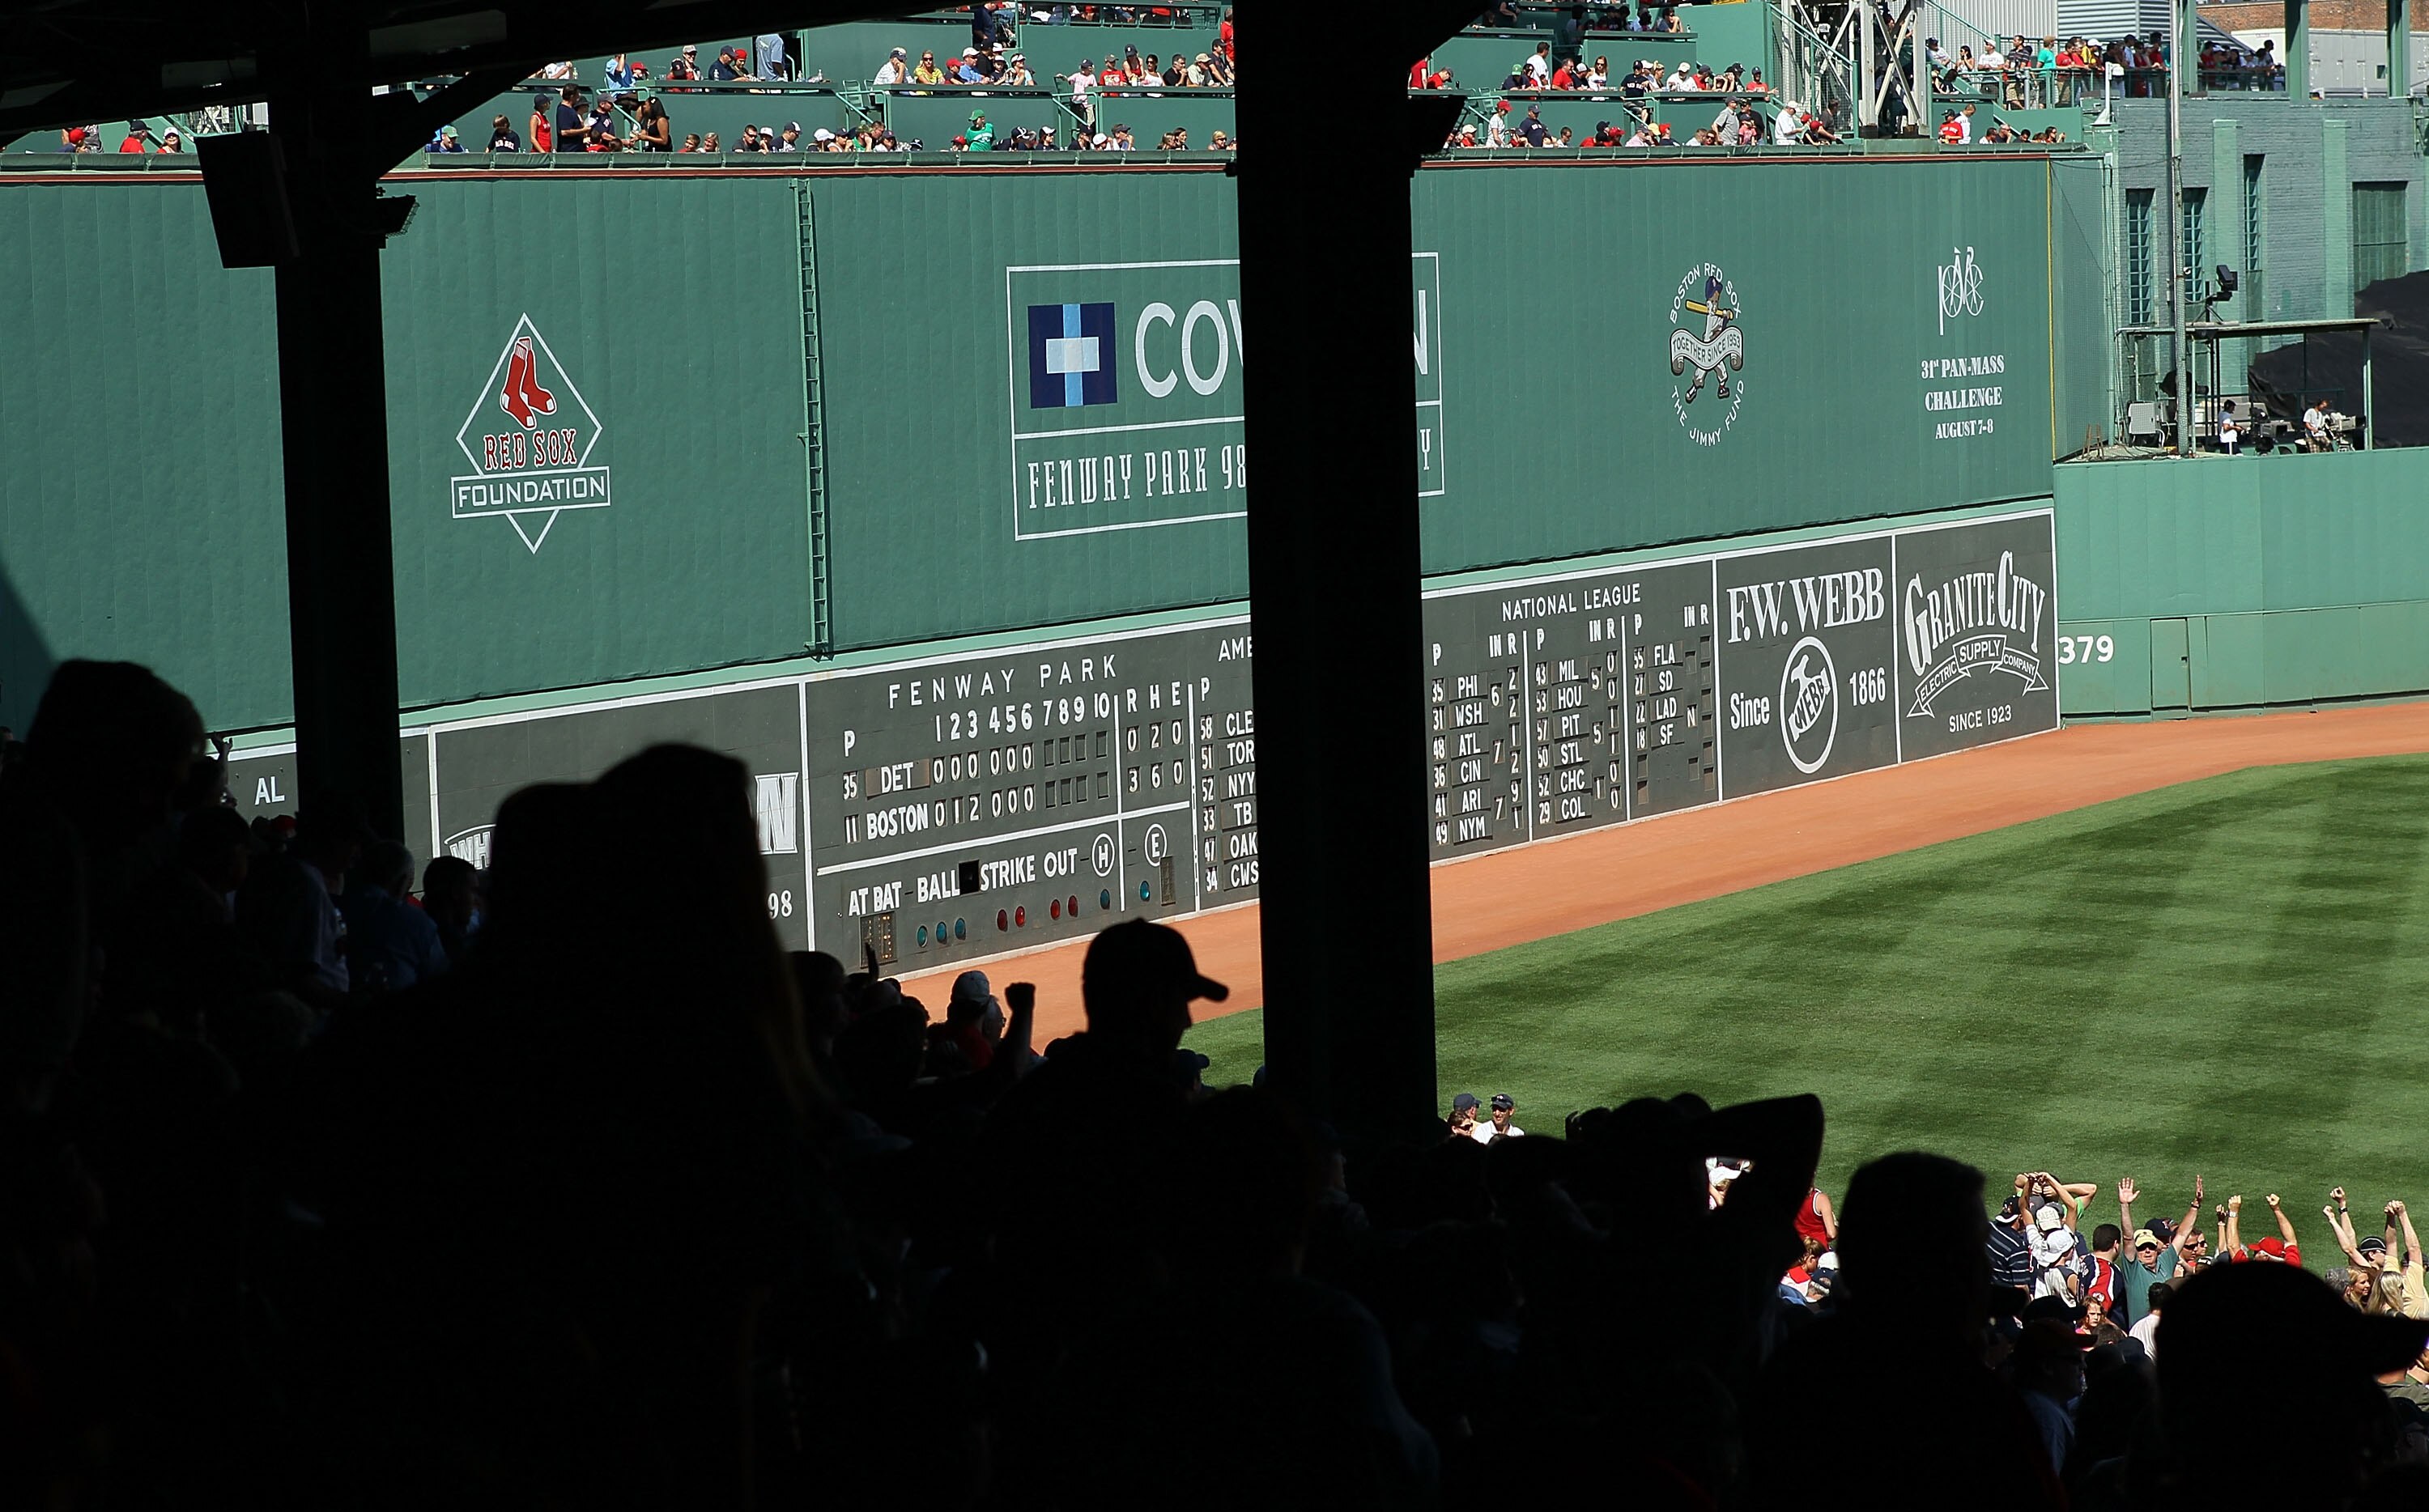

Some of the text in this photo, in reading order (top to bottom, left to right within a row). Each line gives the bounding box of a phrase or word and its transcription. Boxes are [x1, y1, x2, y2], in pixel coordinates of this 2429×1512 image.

[1670, 262, 1742, 324] BOSTON RED SOX
[1673, 334, 1740, 362] TOGETHER SINCE 1953
[1921, 355, 2005, 379] 31st PAN-MASS
[1925, 386, 2002, 411] CHALLENGE
[1671, 380, 1743, 447] THE JIMMY FUND
[1935, 418, 1993, 440] AUGUST 7-8
[484, 429, 576, 470] RED SOX
[458, 476, 605, 507] FOUNDATION
[1027, 453, 1132, 509] FENWAY
[1145, 448, 1208, 497] PARK
[1502, 583, 1641, 622] NATIONAL LEAGUE
[1789, 567, 1885, 632] WEBB
[1634, 604, 1709, 635] P IN R
[1904, 550, 2045, 677] GRANITE CITY
[1537, 618, 1615, 651] P IN R
[1432, 632, 1517, 666] P IN R
[1654, 643, 1675, 665] FLA
[2058, 635, 2114, 665] 379
[889, 654, 1117, 709] FENWAY PARK
[1559, 660, 1579, 682] MIL
[1660, 670, 1673, 691] SD
[1921, 639, 2036, 702] ELECTRIC SUPPLY COMPANY
[1126, 688, 1138, 712] R
[1150, 684, 1160, 710] H
[1172, 681, 1181, 707] E
[1201, 677, 1210, 702] P
[1458, 674, 1478, 698] PHI
[1558, 686, 1582, 709] HOU
[1730, 667, 1886, 729] Since 1866
[1456, 703, 1482, 728] WSH
[1656, 698, 1677, 719] LAD
[1949, 704, 2012, 733] SINCE 1923
[1226, 710, 1253, 737] CLE
[1562, 714, 1580, 737] PIT
[1660, 724, 1674, 745] SF
[844, 730, 856, 757] P
[1227, 740, 1255, 767] TOR
[1458, 733, 1481, 756] ATL
[1560, 741, 1583, 765] STL
[843, 773, 857, 801] 35
[881, 762, 914, 794] DET
[1461, 759, 1481, 783] CIN
[1560, 769, 1585, 792] CHC
[254, 775, 285, 805] AL
[1228, 771, 1255, 799] NYY
[1234, 801, 1253, 827] TB
[1461, 788, 1481, 813] ARI
[1561, 796, 1585, 819] COL
[866, 803, 929, 840] BOSTON
[1459, 816, 1485, 839] NYM
[1099, 843, 1108, 869] H
[1151, 833, 1160, 858] E
[1230, 830, 1257, 859] OAK
[849, 847, 1078, 917] AT BAT BALL STRIKE OUT
[1231, 861, 1259, 888] CWS
